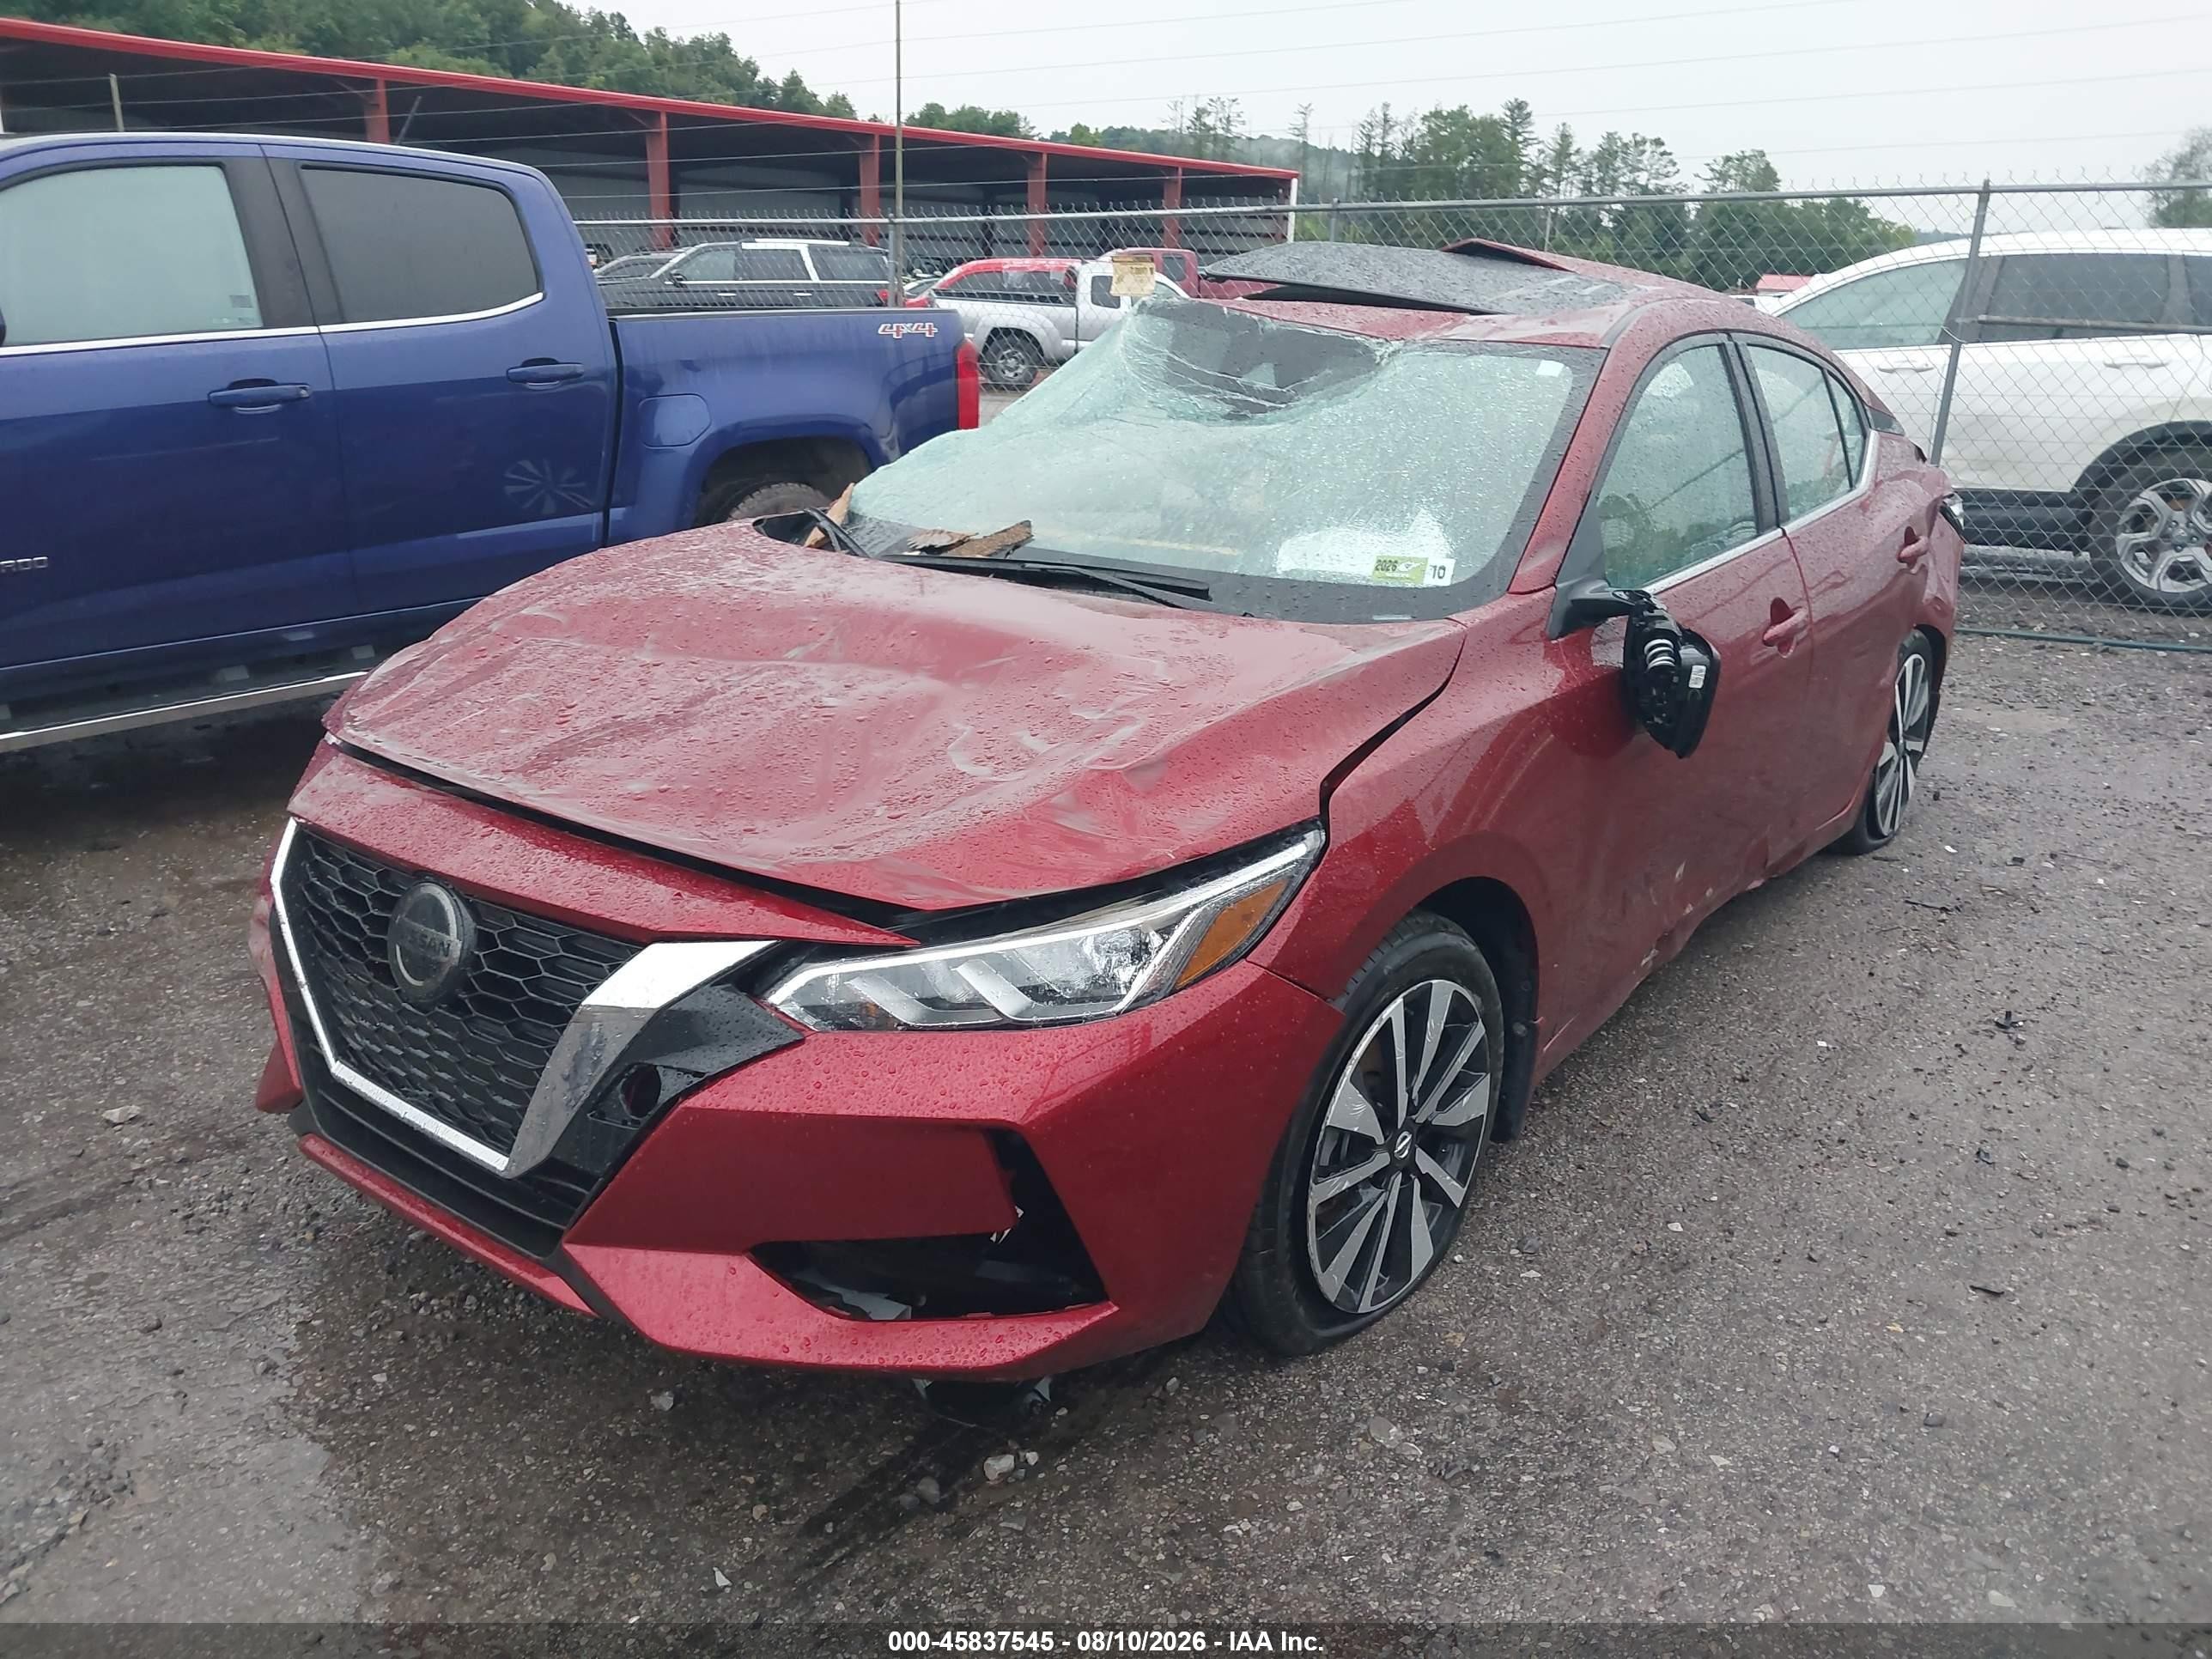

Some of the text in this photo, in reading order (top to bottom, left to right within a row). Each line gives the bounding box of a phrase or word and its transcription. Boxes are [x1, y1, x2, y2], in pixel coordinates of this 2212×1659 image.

[1374, 559, 1399, 572] 2026
[1430, 564, 1447, 580] 10
[395, 924, 451, 957] SSAN
